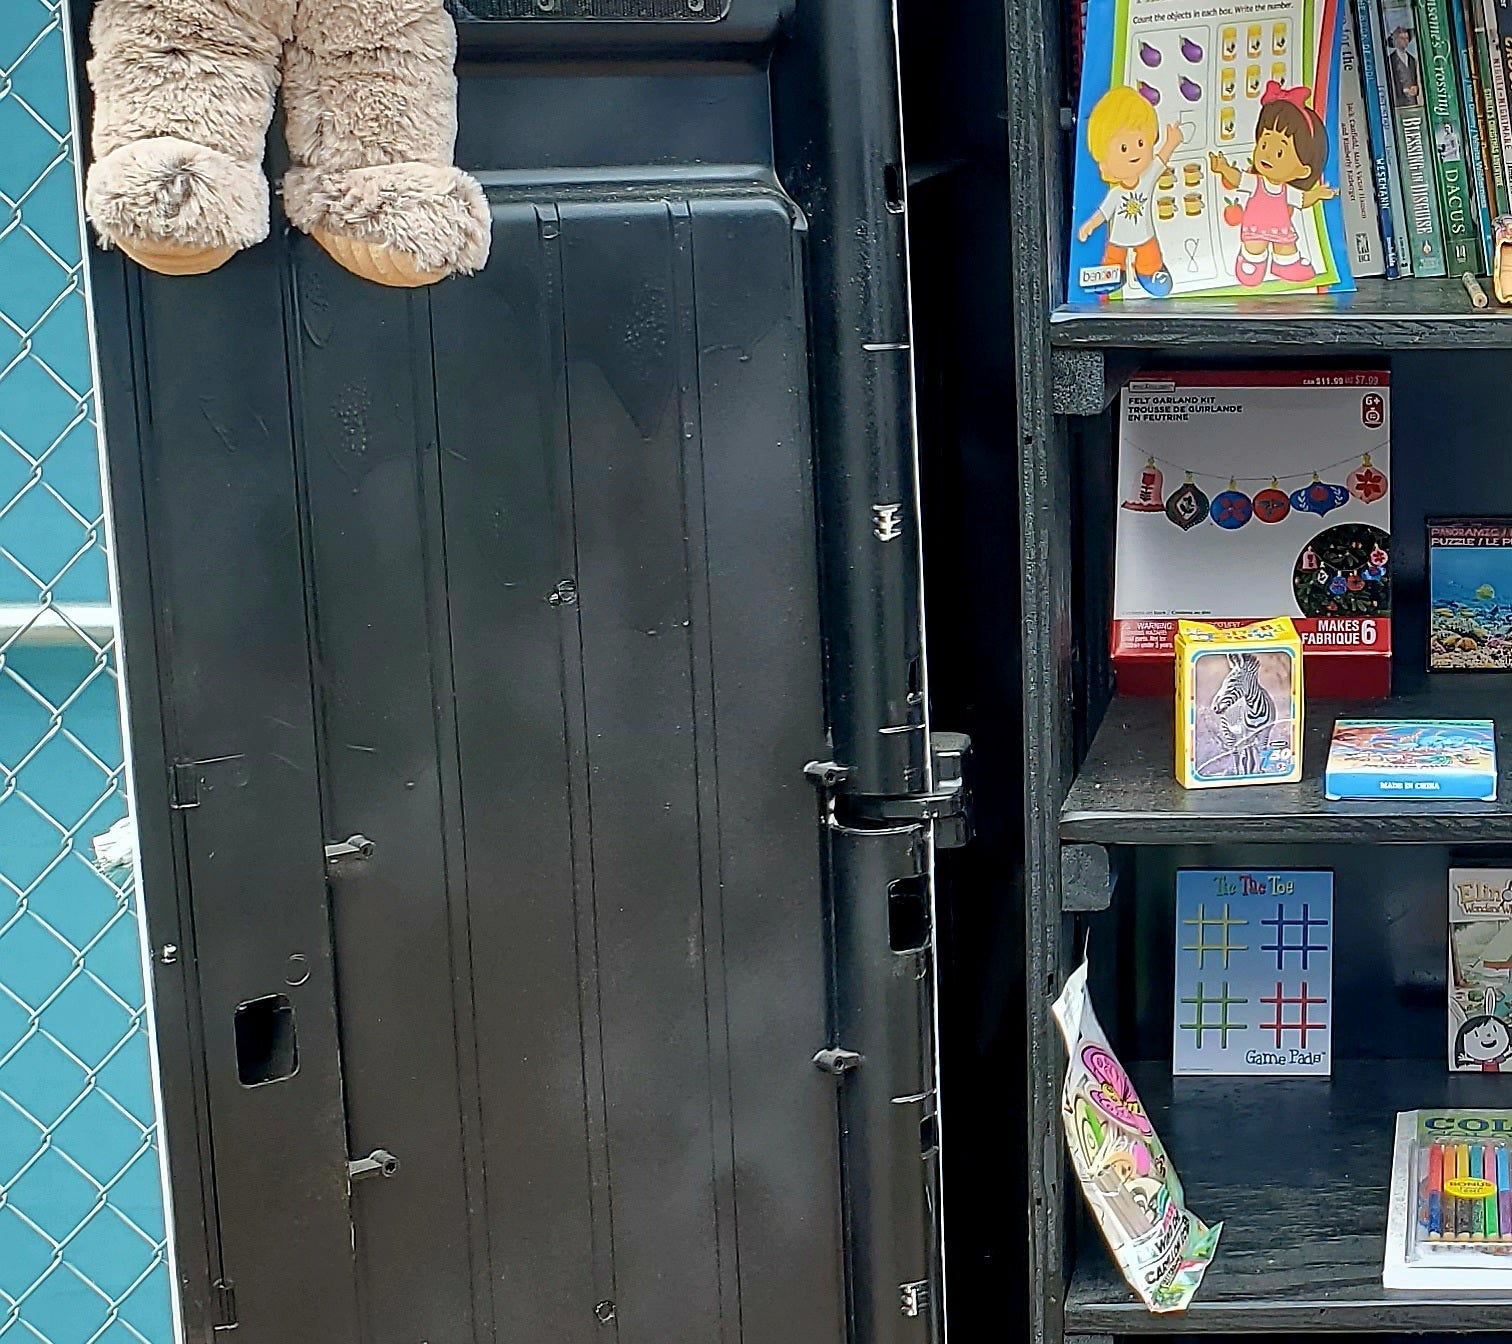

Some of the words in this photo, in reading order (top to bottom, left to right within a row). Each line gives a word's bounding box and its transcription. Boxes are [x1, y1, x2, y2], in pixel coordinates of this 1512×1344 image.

[1133, 14, 1152, 24] Count
[1154, 14, 1165, 22] the
[1167, 11, 1192, 23] objects
[1202, 9, 1217, 18] each
[1219, 8, 1233, 16] box.
[1235, 5, 1253, 14] Write
[1255, 4, 1265, 12] the
[1267, 2, 1293, 11] number.
[1444, 170, 1465, 234] DACUS
[1318, 620, 1359, 632] MAKES
[1361, 620, 1376, 644] 6
[1302, 633, 1360, 644] FABRIQUE
[1214, 876, 1236, 896] Tic
[1240, 875, 1266, 896] Tac
[1268, 875, 1294, 895] Toe
[1246, 1050, 1285, 1065] Game
